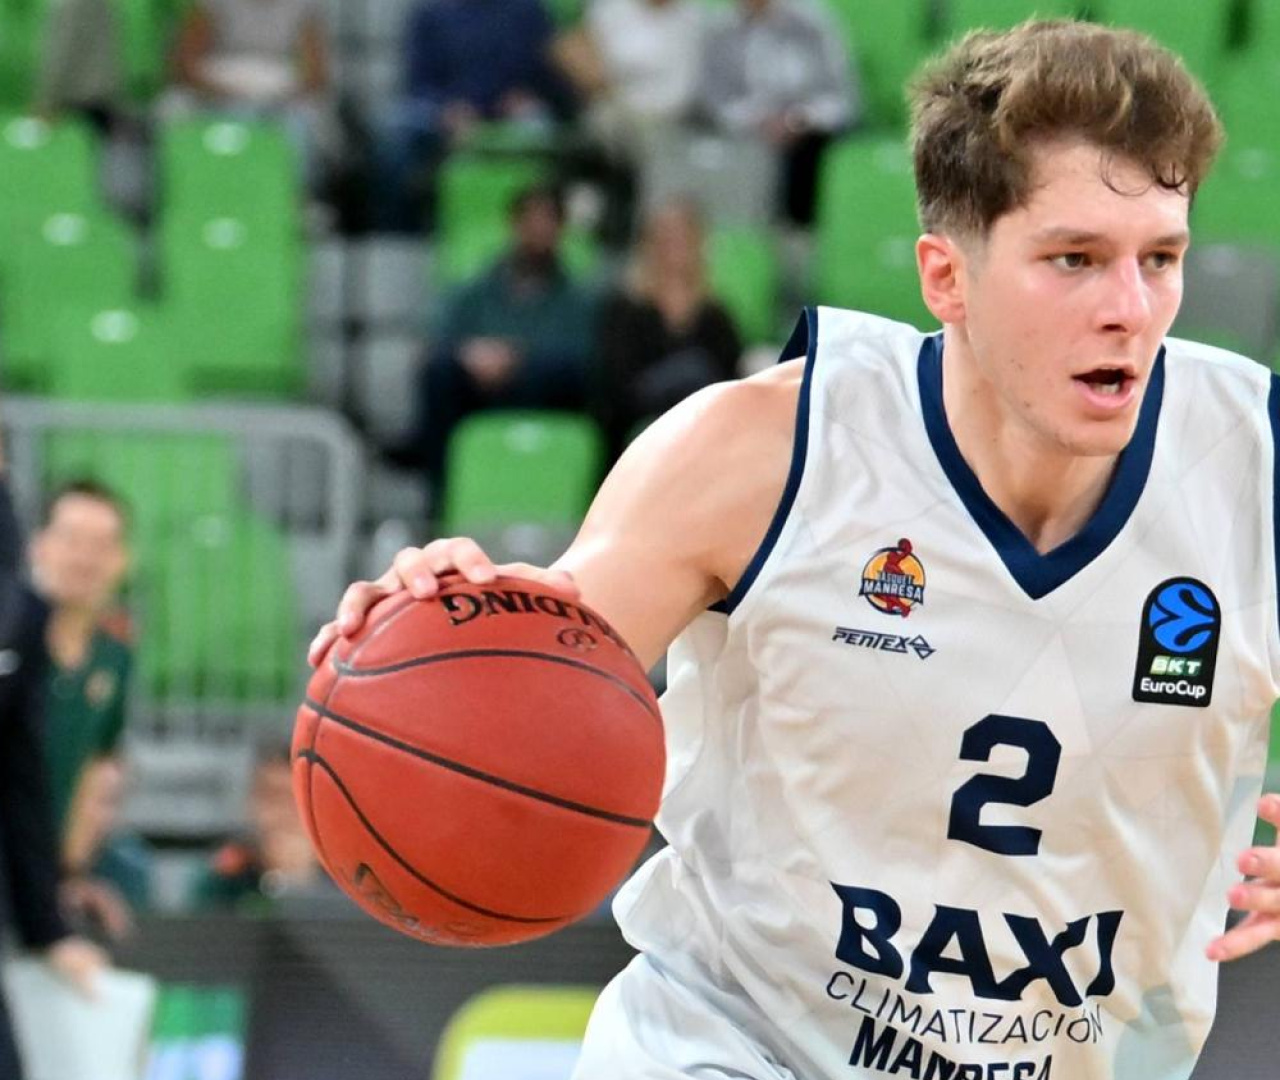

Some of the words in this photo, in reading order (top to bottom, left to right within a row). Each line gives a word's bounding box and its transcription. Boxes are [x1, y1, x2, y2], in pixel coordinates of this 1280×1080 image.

[863, 580, 922, 601] MANRESA
[1150, 655, 1202, 676] BKT
[1140, 677, 1207, 699] EuroCup
[947, 713, 1062, 856] 2
[829, 880, 1124, 1007] BAXI
